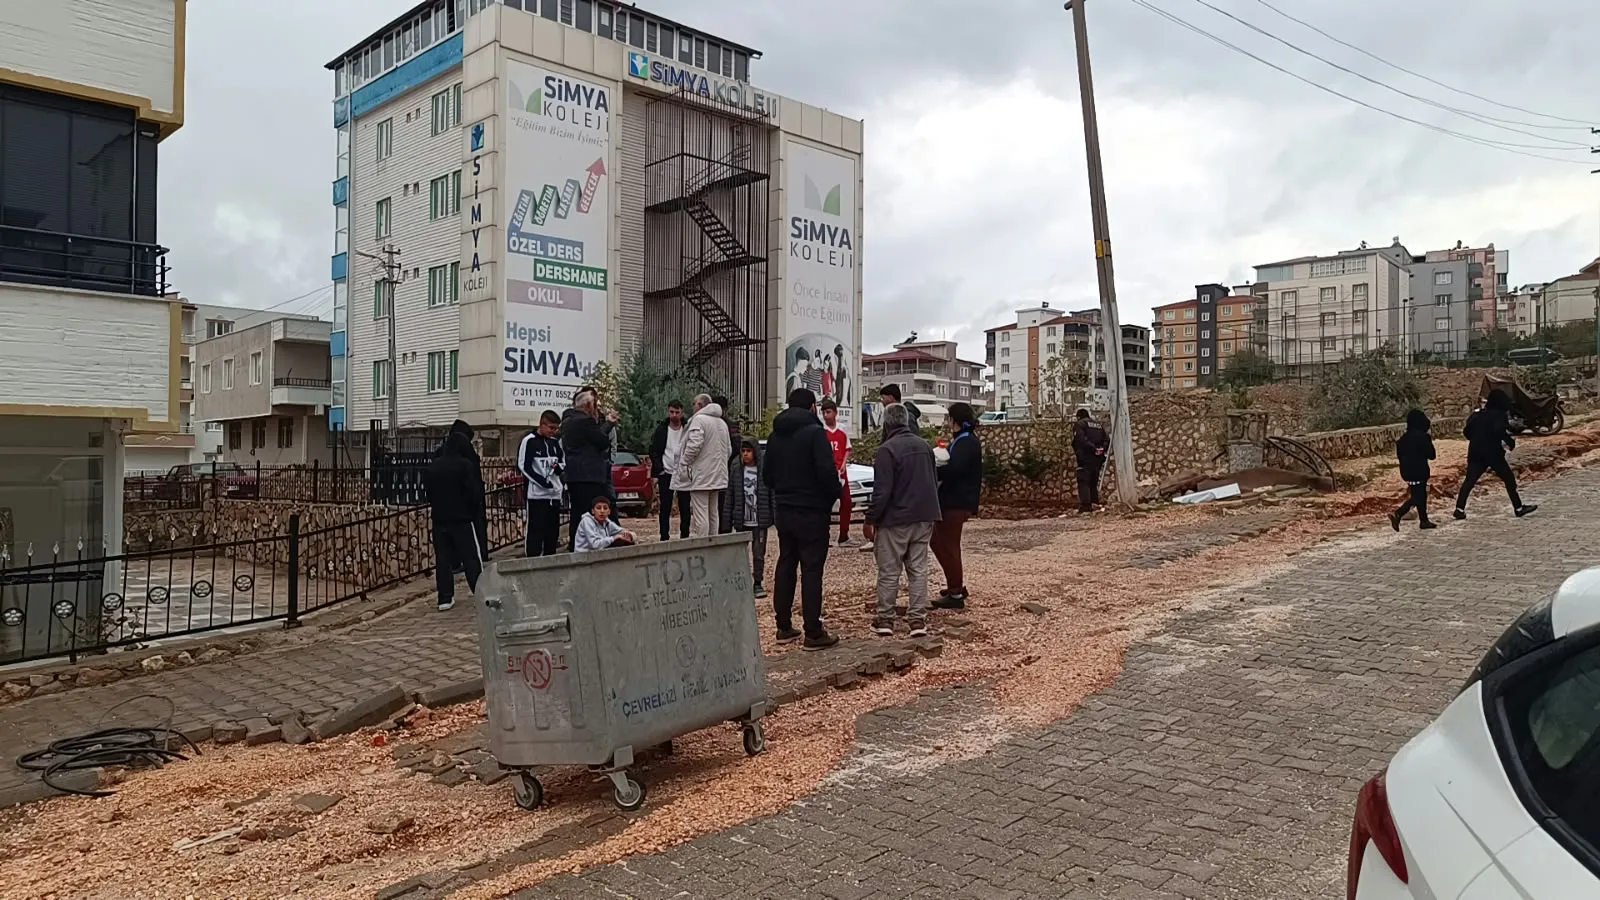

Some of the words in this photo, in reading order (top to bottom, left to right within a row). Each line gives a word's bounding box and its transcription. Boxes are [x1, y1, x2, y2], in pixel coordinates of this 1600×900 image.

[549, 125, 575, 140] Bizim
[557, 181, 575, 218] BAŞARI
[580, 170, 600, 212] GELECEK
[509, 232, 544, 255] ÖZEL
[547, 242, 582, 261] DERS
[536, 263, 605, 287] DERSHANE
[527, 286, 564, 305] OKUL
[790, 297, 817, 319] Önce
[506, 321, 551, 345] Hepsi
[520, 387, 532, 397] 311
[544, 389, 553, 398] 77
